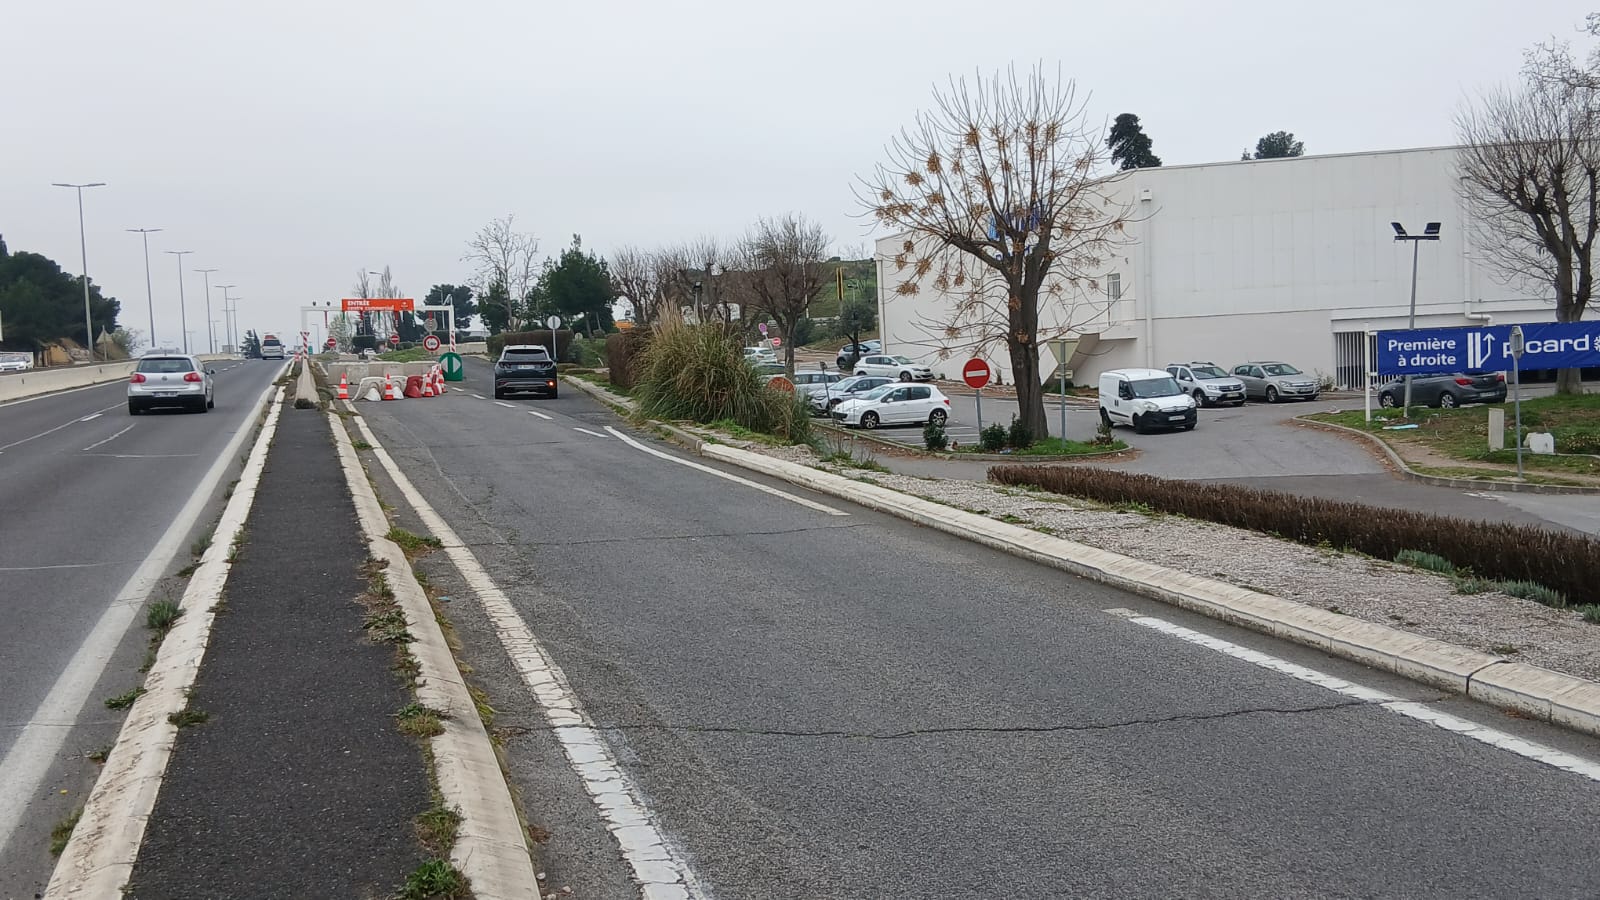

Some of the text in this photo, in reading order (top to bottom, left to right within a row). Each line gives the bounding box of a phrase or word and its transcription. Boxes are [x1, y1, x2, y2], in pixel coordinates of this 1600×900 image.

[1388, 338, 1456, 352] Première
[1398, 353, 1456, 367] à droite
